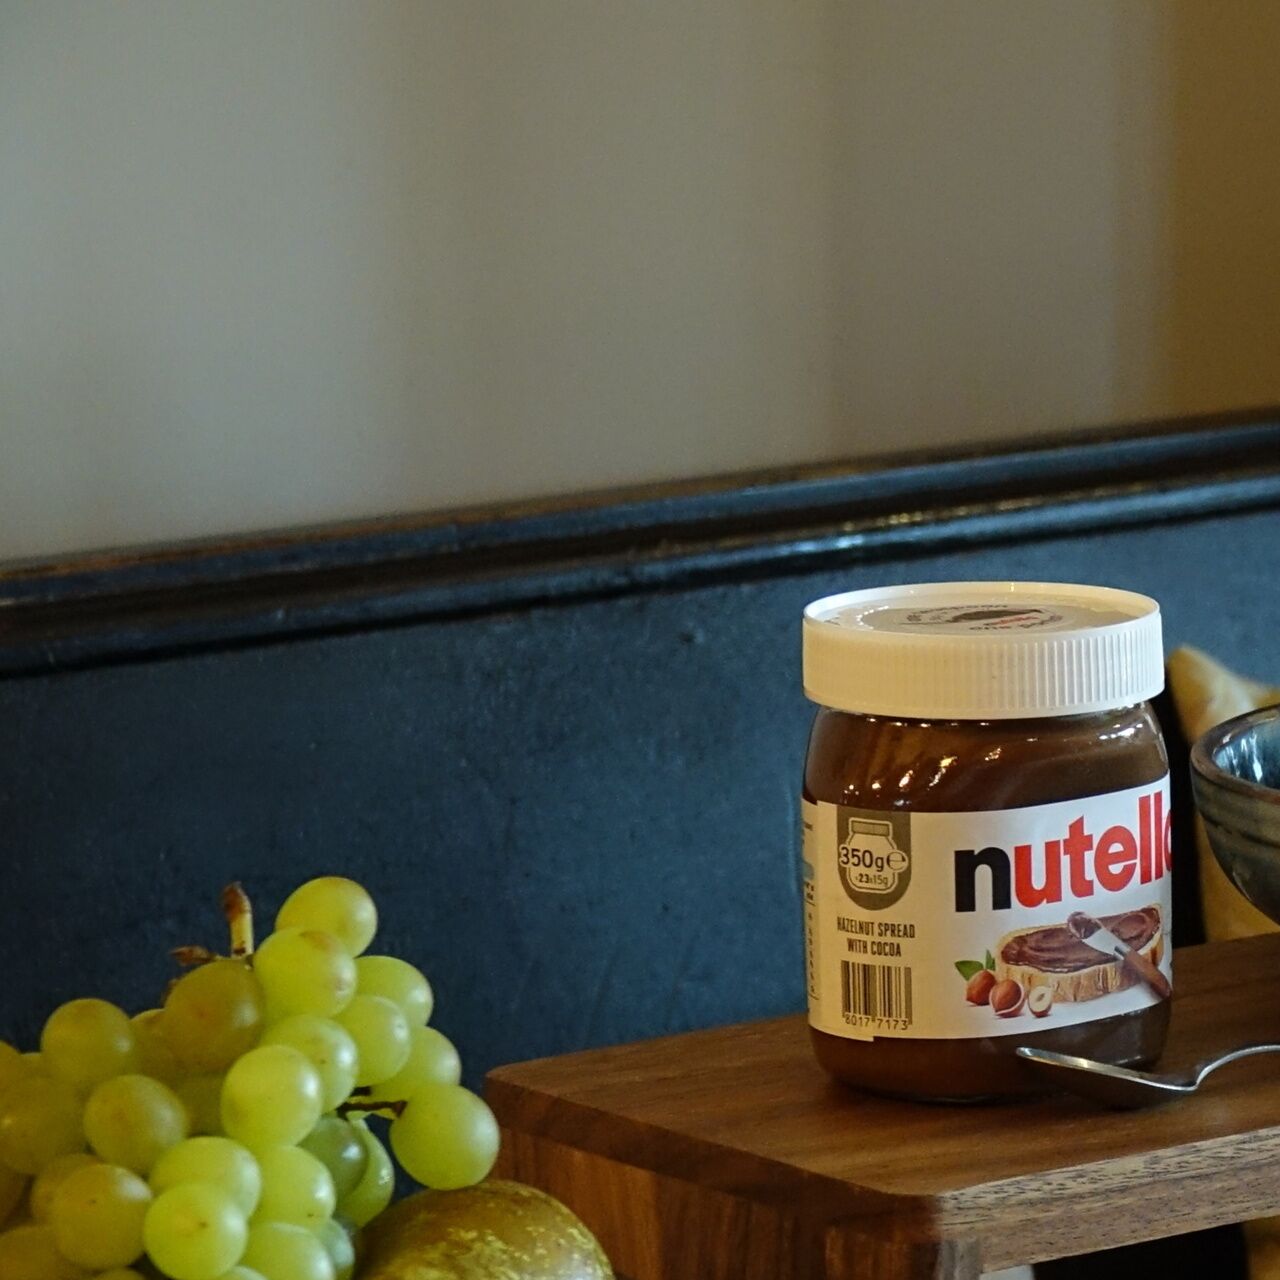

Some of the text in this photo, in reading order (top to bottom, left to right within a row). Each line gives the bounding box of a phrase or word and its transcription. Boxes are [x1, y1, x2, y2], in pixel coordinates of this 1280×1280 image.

[837, 915, 916, 939] HAZELNUT SPREAD
[847, 938, 902, 957] WITH COCOA
[845, 1012, 908, 1031] 8017 7173
